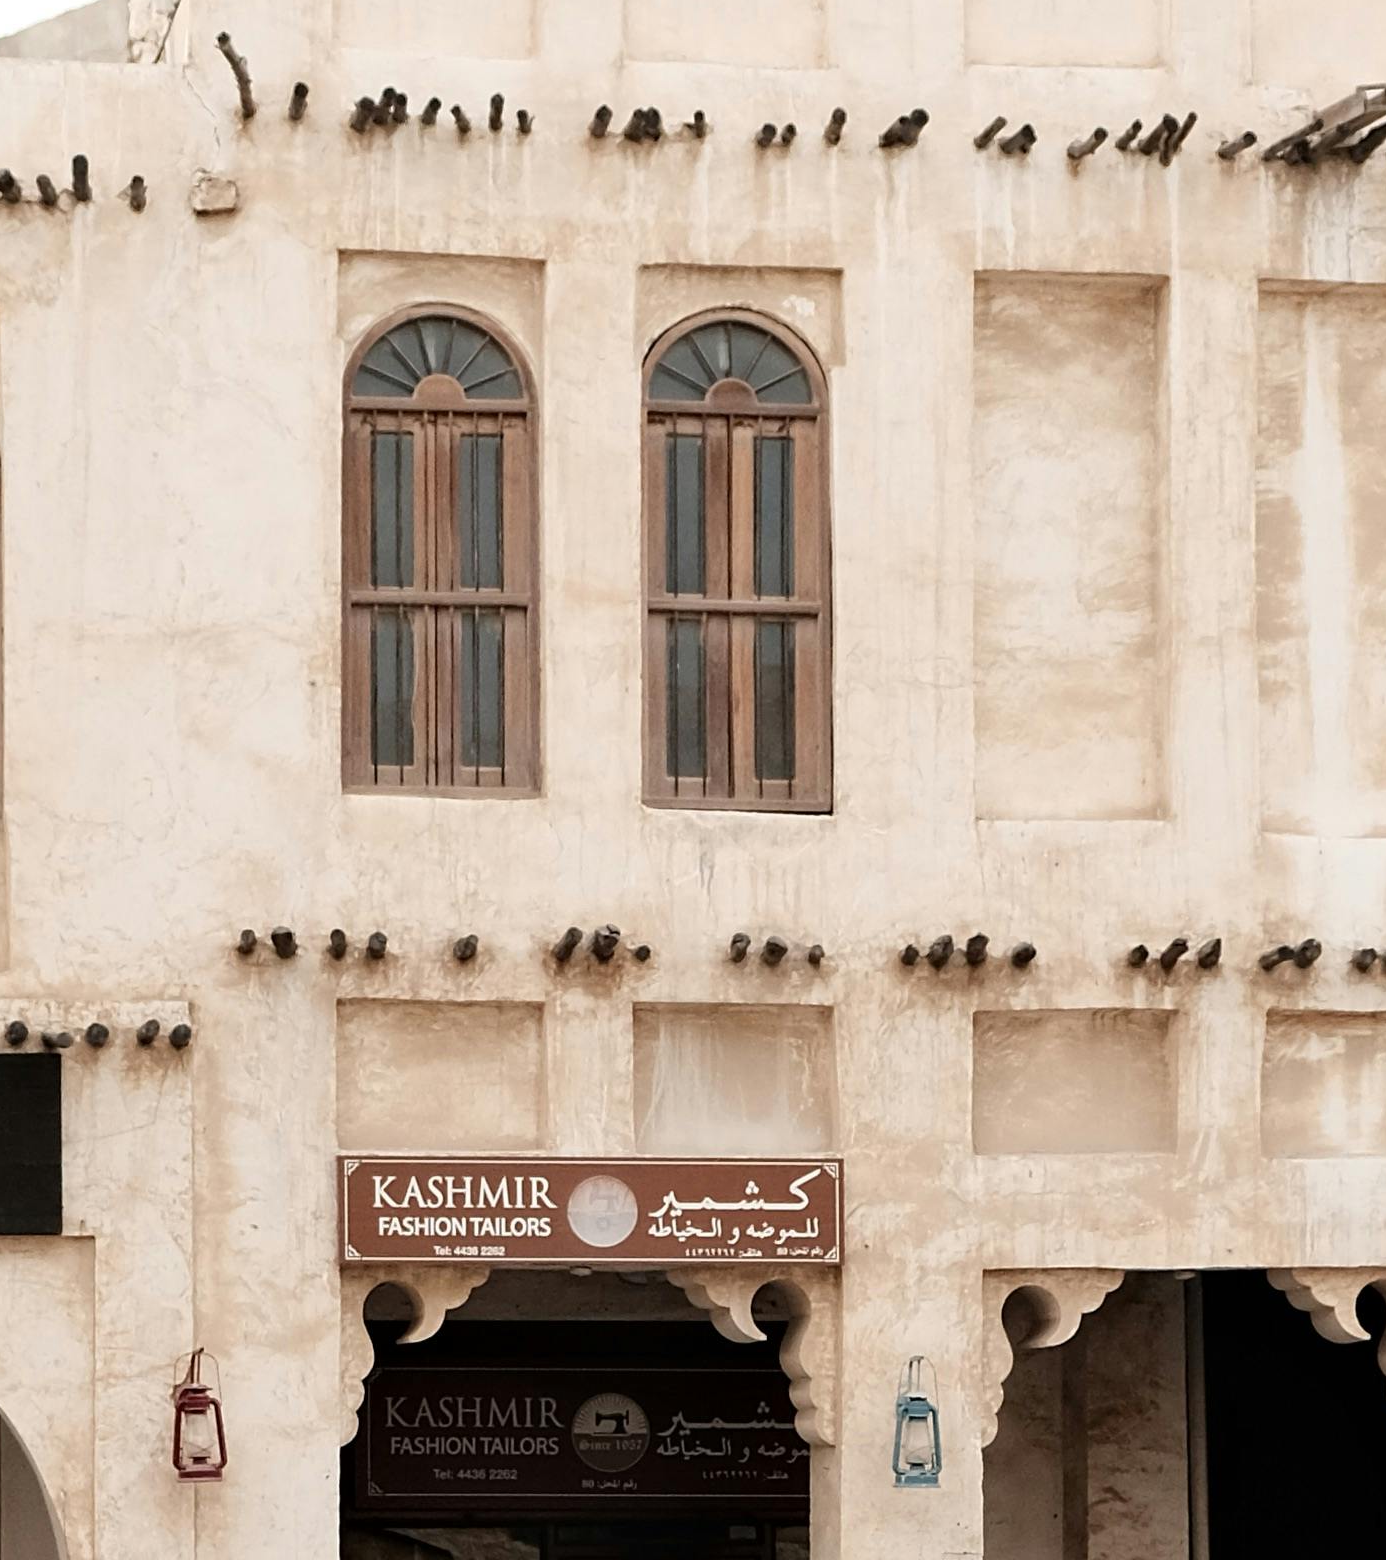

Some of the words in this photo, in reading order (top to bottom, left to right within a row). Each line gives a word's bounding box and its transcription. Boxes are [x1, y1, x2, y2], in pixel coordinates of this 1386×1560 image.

[372, 1175, 558, 1209] KASHMIR
[648, 1168, 821, 1217] كشمير
[378, 1216, 467, 1237] FASHION
[469, 1216, 552, 1237] TAILORS
[648, 1216, 722, 1243] الخياطه
[727, 1226, 741, 1245] و
[746, 1217, 819, 1245] للموضه
[433, 1245, 452, 1256] Tel:
[385, 1396, 565, 1429] KASHMIR
[657, 1401, 796, 1436] شمير
[390, 1436, 476, 1456] FASHION
[479, 1436, 559, 1456] TAILORS
[656, 1437, 732, 1461] الخياطه
[738, 1446, 751, 1464] و
[757, 1441, 811, 1464] موضه
[433, 1468, 454, 1480] Tel:
[456, 1468, 487, 1480] 4436
[488, 1468, 518, 1481] 2262
